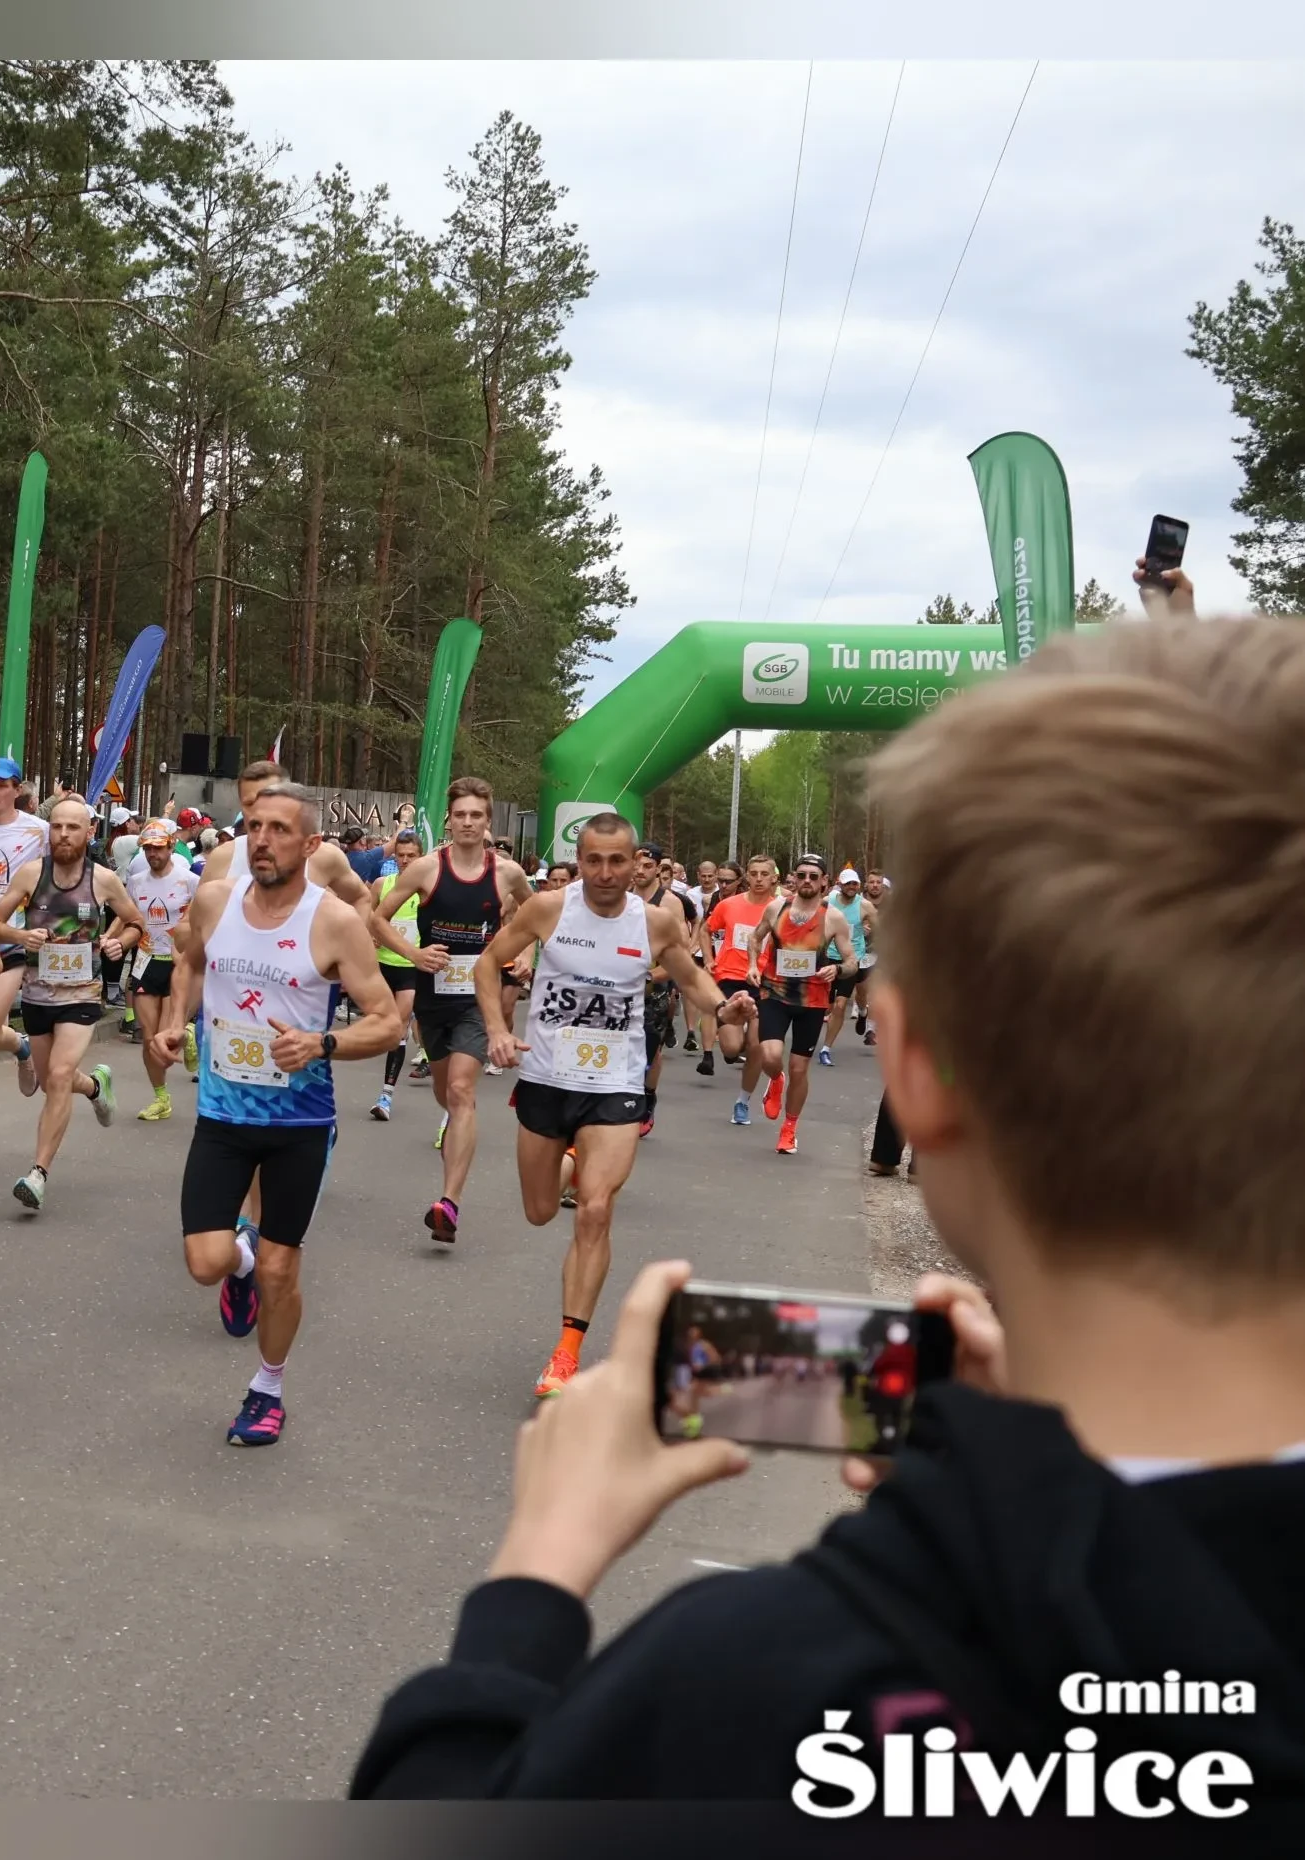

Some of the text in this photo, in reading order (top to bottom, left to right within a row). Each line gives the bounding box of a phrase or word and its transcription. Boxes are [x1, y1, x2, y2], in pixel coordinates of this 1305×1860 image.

[764, 663, 788, 674] SGB
[827, 643, 1008, 676] Tu mamy ws
[755, 687, 795, 697] MOBILE
[826, 685, 854, 705] w
[316, 793, 385, 828] ŚNA
[555, 935, 596, 948] MARCIN
[48, 953, 84, 971] 214
[782, 957, 809, 970] 284
[227, 1038, 264, 1067] 38
[576, 1043, 609, 1069] 93
